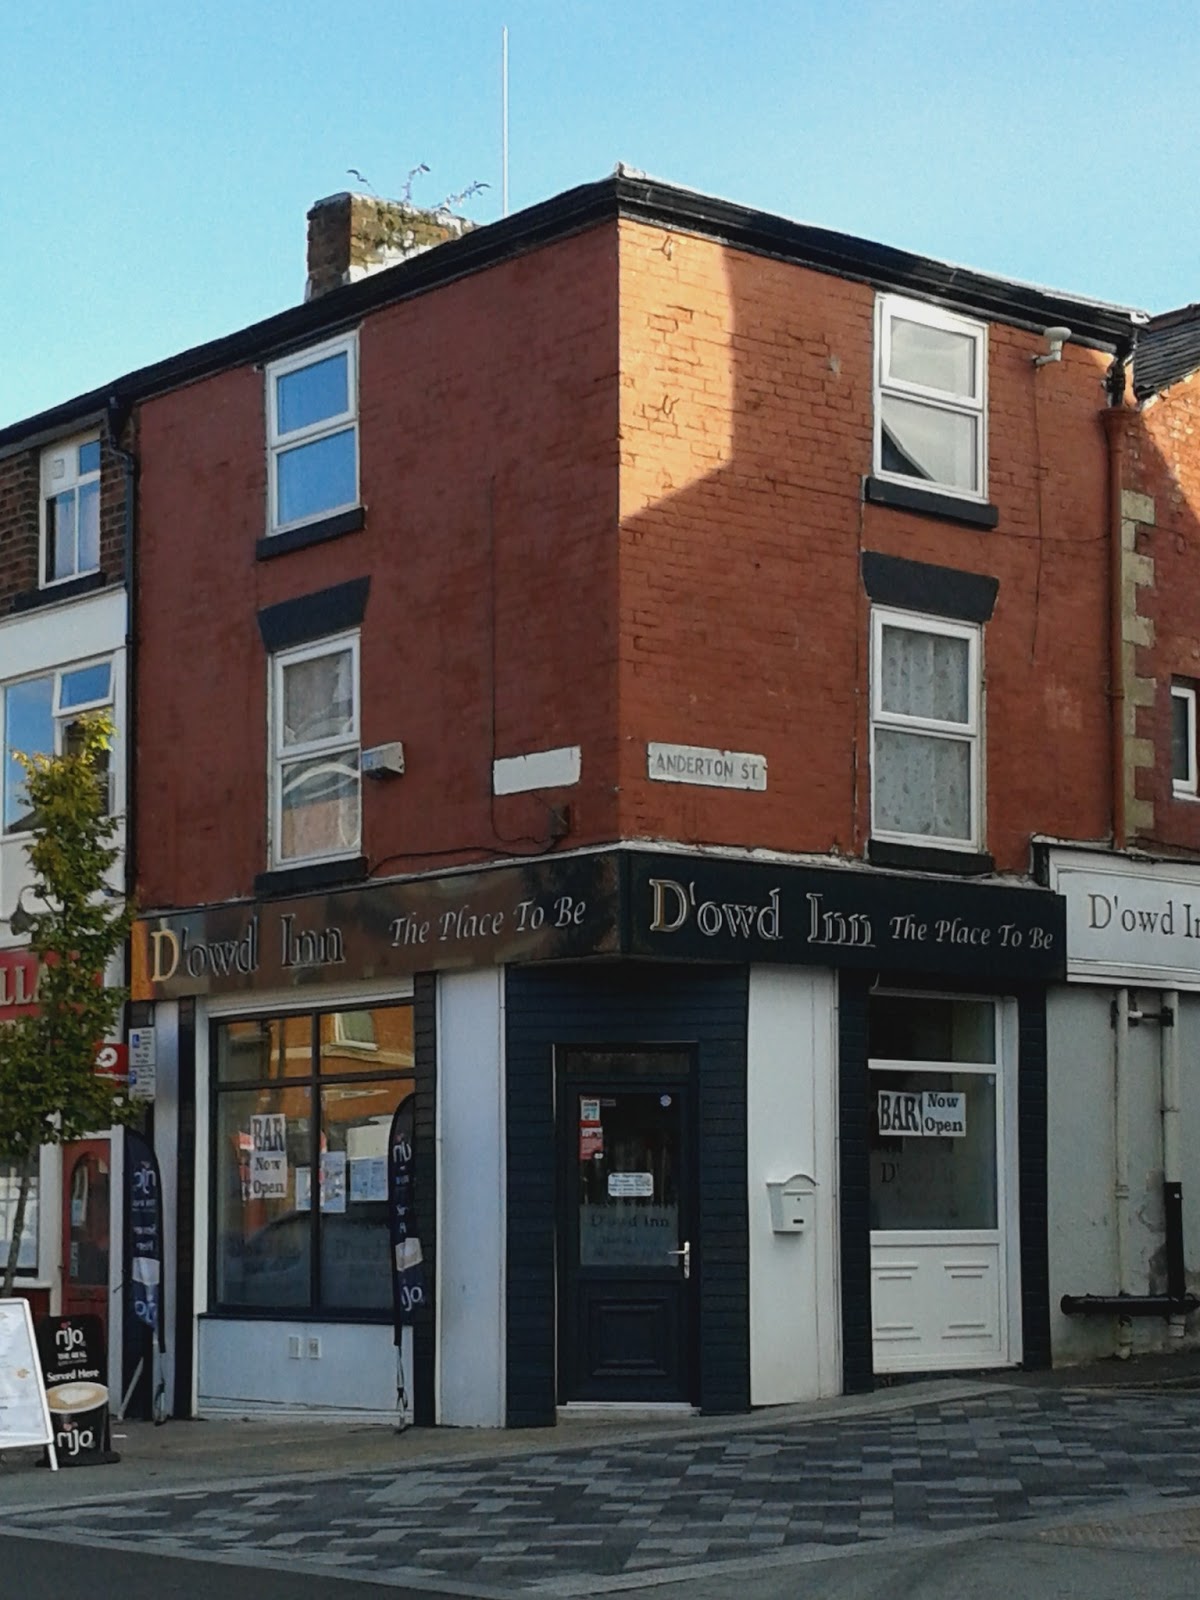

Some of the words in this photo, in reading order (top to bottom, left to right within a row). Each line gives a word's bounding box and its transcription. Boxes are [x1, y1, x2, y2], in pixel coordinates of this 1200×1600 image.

[656, 752, 734, 778] ANDERTON
[741, 762, 758, 779] ST
[649, 878, 783, 940] D'owd
[806, 892, 876, 948] Inn
[890, 914, 927, 941] The
[935, 918, 990, 945] Place
[998, 924, 1022, 947] To
[1028, 927, 1054, 949] Be
[1088, 893, 1175, 936] D'owd
[150, 915, 260, 981] D'owd
[280, 913, 346, 968] Inn
[389, 911, 430, 947] The
[440, 904, 504, 940] Place
[513, 898, 544, 931] To
[554, 896, 586, 927] Be
[927, 1093, 959, 1108] Now
[880, 1094, 919, 1132] BAR
[252, 1117, 284, 1152] BAR
[924, 1117, 963, 1135] Open
[254, 1157, 281, 1171] Now
[253, 1180, 285, 1198] Open
[644, 1215, 669, 1228] Inn
[77, 1368, 100, 1380] Here
